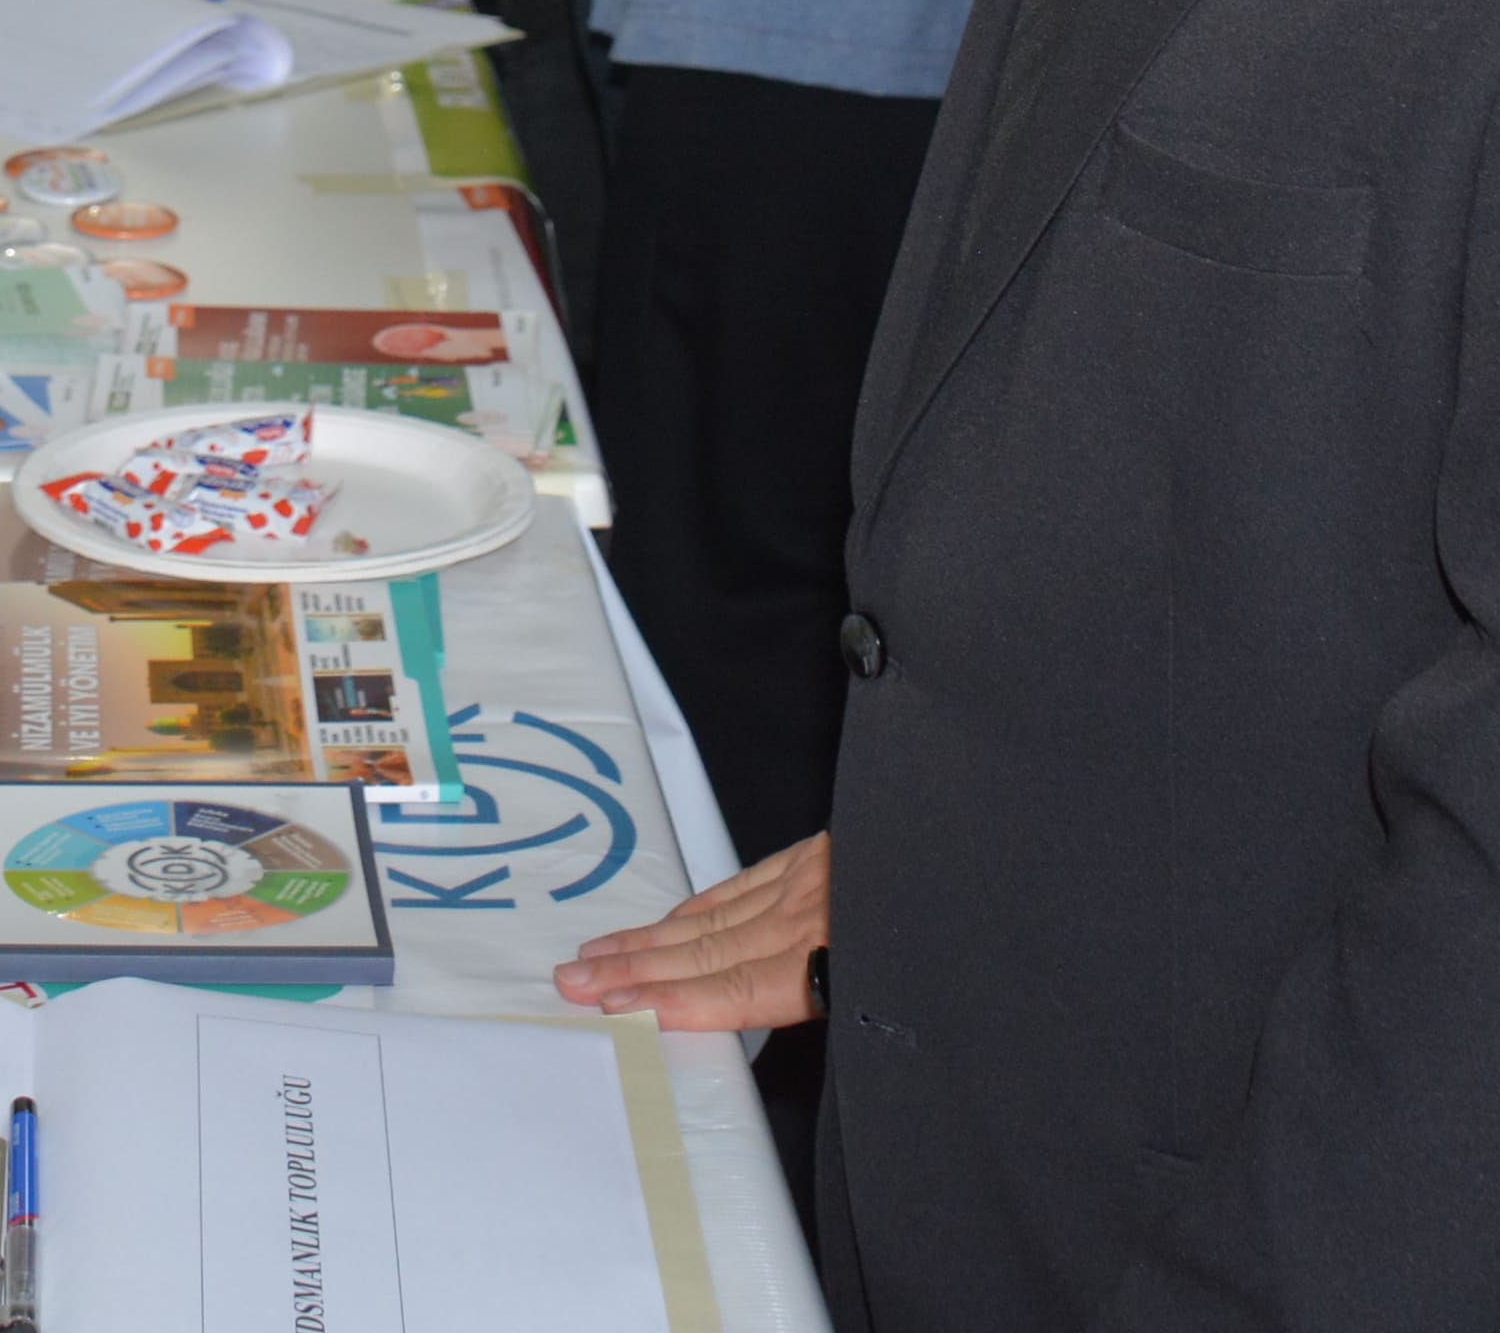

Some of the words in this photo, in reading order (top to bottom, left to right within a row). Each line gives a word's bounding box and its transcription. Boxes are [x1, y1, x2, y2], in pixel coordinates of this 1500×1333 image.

[12, 624, 53, 751] NİZAMÜLMÜLK
[59, 625, 100, 701] YÖNETİM
[59, 705, 100, 727] İYİ
[69, 730, 100, 751] VE
[160, 844, 198, 895] KDK
[276, 1074, 319, 1203] TOPLULUĞU
[289, 1206, 327, 1333] DSMANLIK
